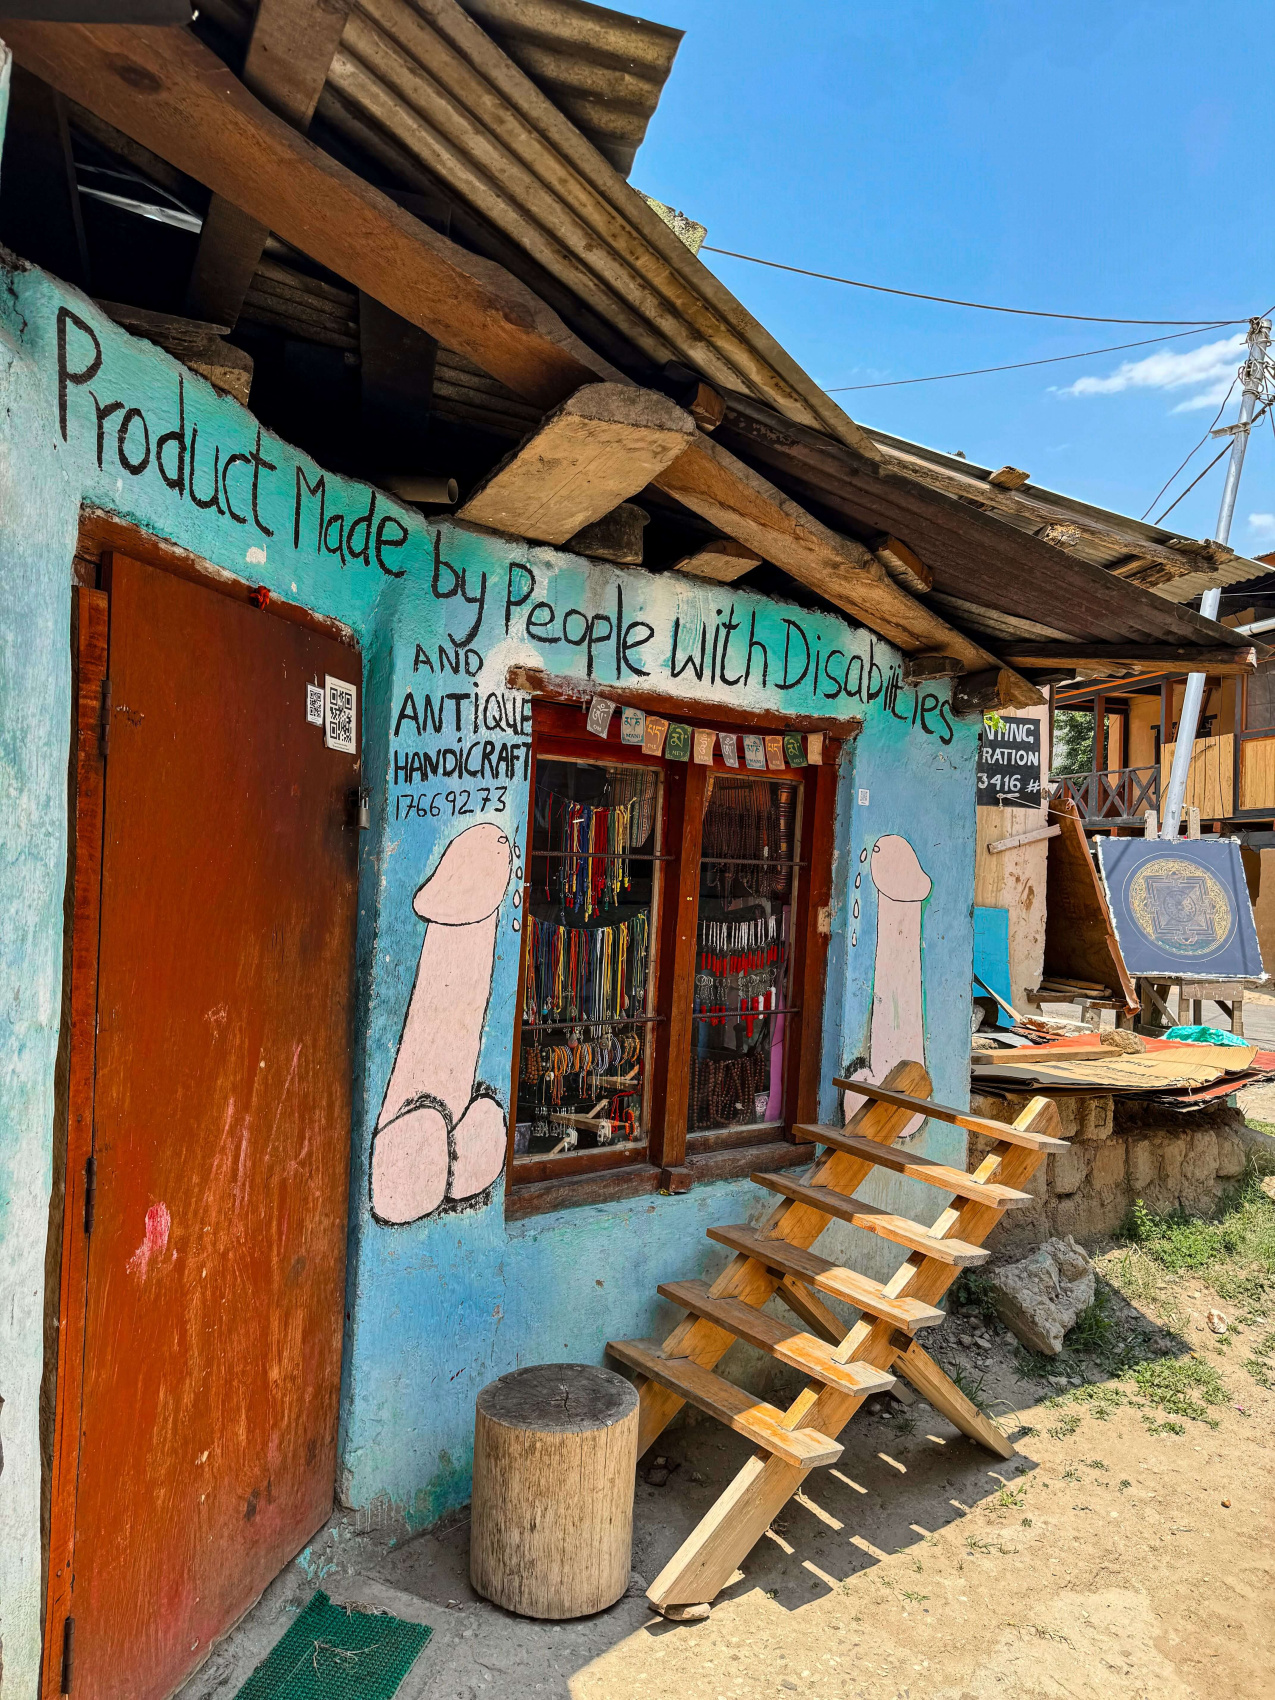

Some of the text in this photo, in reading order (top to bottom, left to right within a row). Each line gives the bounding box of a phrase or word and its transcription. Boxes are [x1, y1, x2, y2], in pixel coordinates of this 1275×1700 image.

[56, 305, 278, 538] Product
[293, 465, 409, 578] Made
[430, 529, 487, 648] by
[504, 561, 655, 681] People
[670, 603, 769, 688] With
[412, 643, 484, 677] AND
[981, 747, 1039, 767] RATION
[976, 772, 1021, 792] 3416
[395, 785, 508, 821] 17669273
